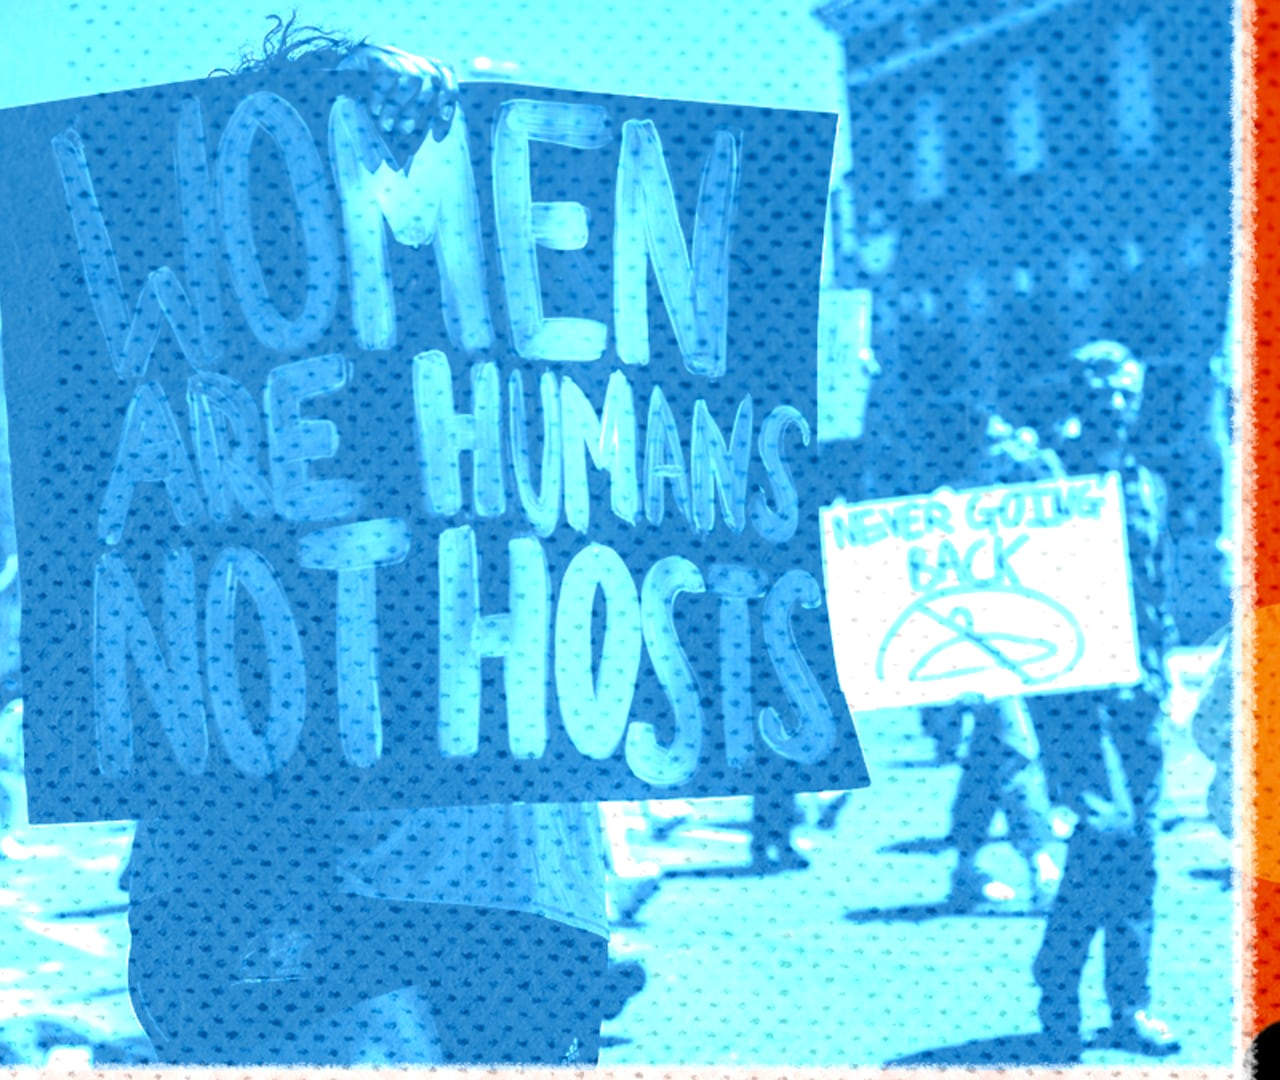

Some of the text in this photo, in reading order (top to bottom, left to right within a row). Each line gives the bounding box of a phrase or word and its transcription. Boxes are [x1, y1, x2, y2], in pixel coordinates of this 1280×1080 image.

[51, 91, 742, 378] WOMEN
[97, 353, 366, 545] ARE
[412, 350, 811, 543] HUMANS
[831, 484, 1105, 549] NEVER GOING
[93, 517, 412, 776] NOT
[438, 524, 836, 787] HOSTS
[907, 534, 1030, 591] BACK
